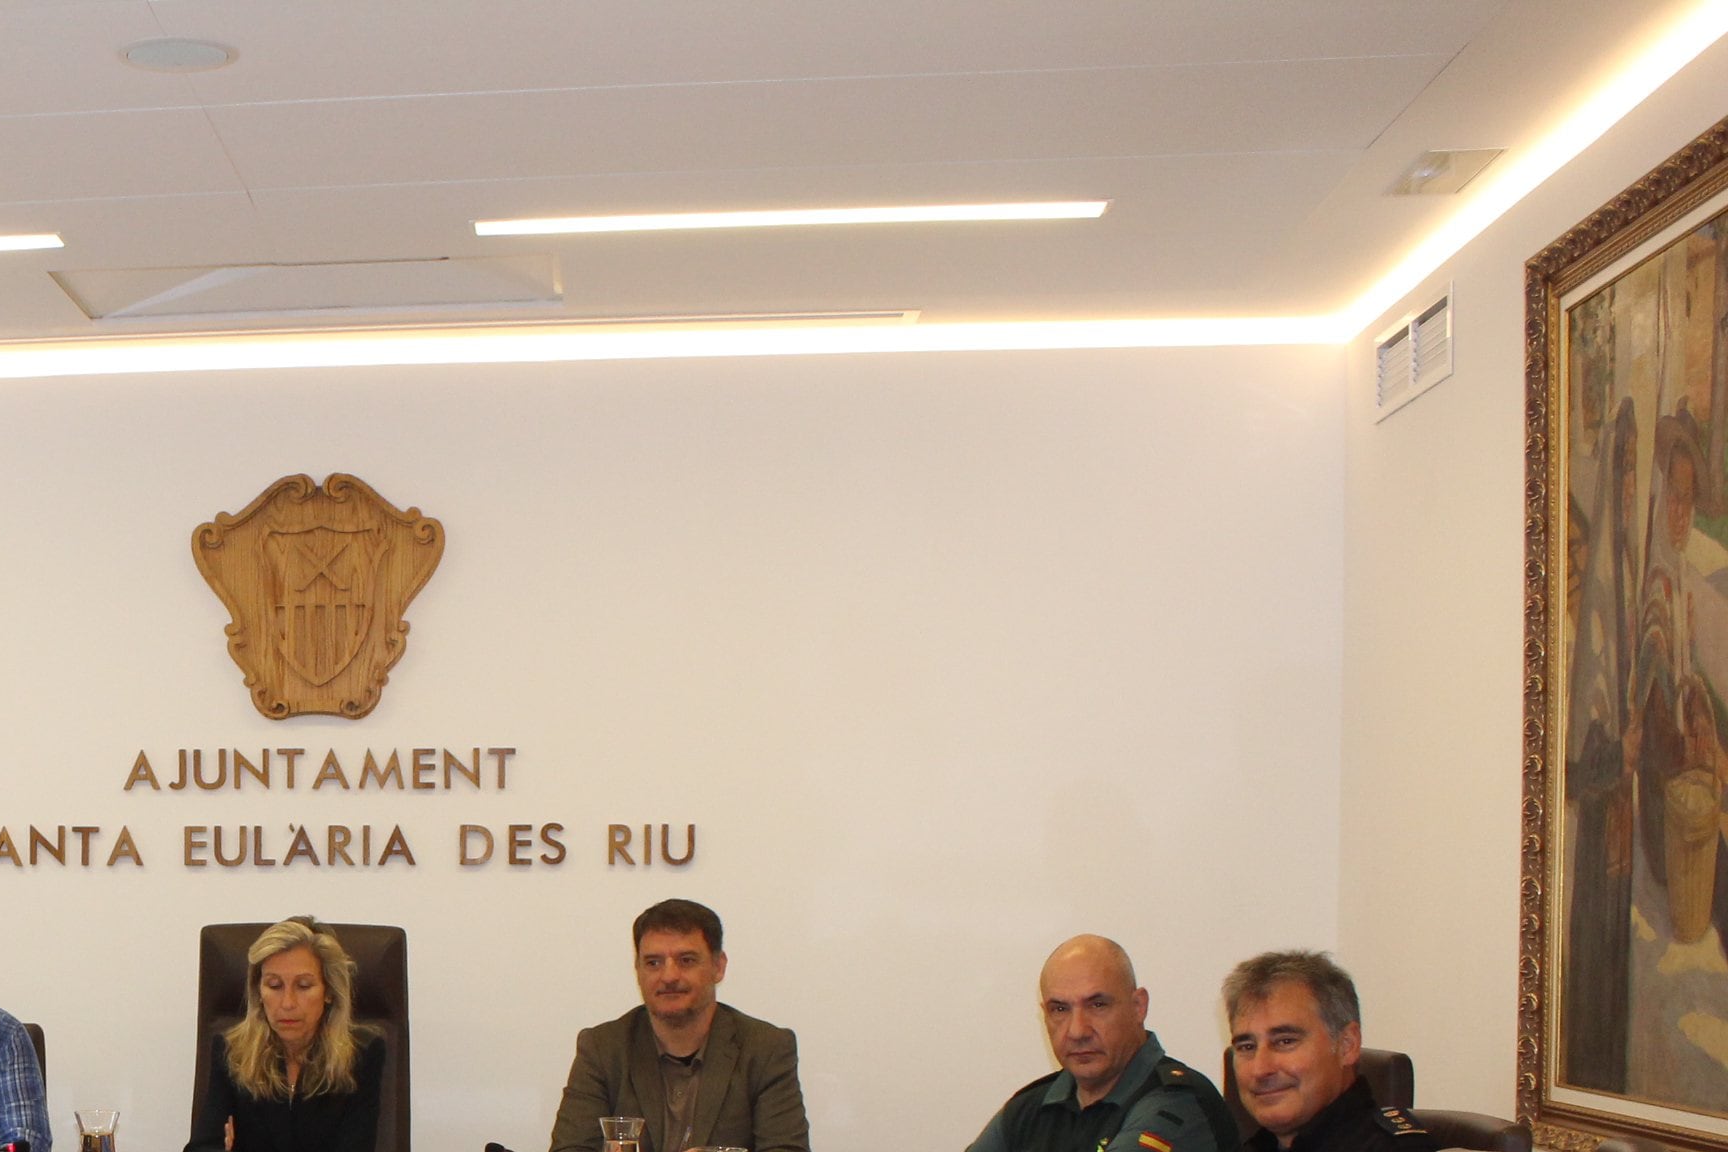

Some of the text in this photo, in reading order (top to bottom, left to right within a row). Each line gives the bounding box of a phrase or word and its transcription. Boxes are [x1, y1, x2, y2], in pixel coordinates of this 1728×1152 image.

[123, 747, 517, 791] AJUNTAMENT
[183, 823, 417, 868] EULÀRIA
[459, 822, 567, 867] DES
[608, 823, 697, 868] RIU
